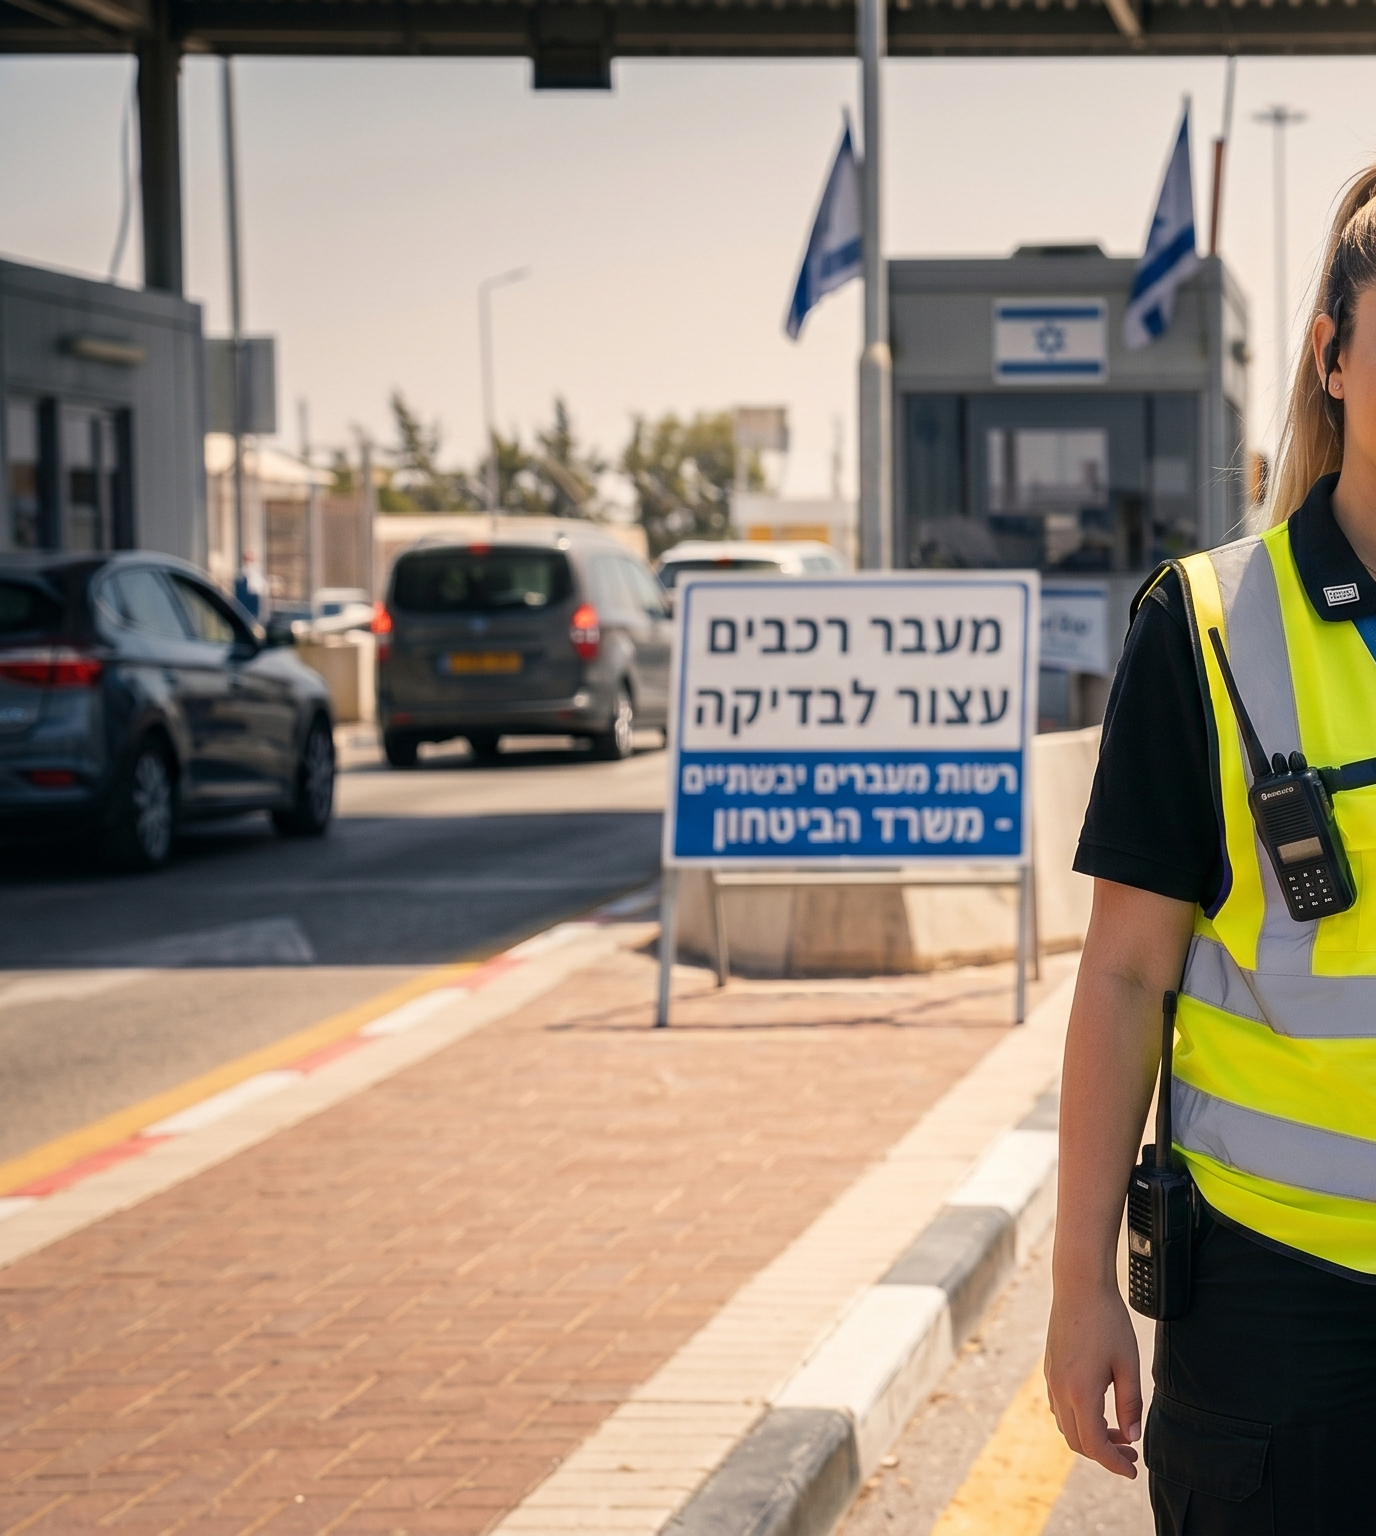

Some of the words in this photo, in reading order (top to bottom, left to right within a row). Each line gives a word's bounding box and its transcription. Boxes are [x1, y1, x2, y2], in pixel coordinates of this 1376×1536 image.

[706, 616, 850, 656] רכבים
[869, 616, 1003, 656] מעבר
[695, 677, 878, 738] לבדיקה
[896, 687, 1010, 727] עצור
[682, 763, 807, 796] יבשתיים
[814, 762, 931, 795] מעברים
[935, 762, 1018, 795] רשות
[713, 806, 861, 852] הביטחון
[872, 806, 985, 844] משרד
